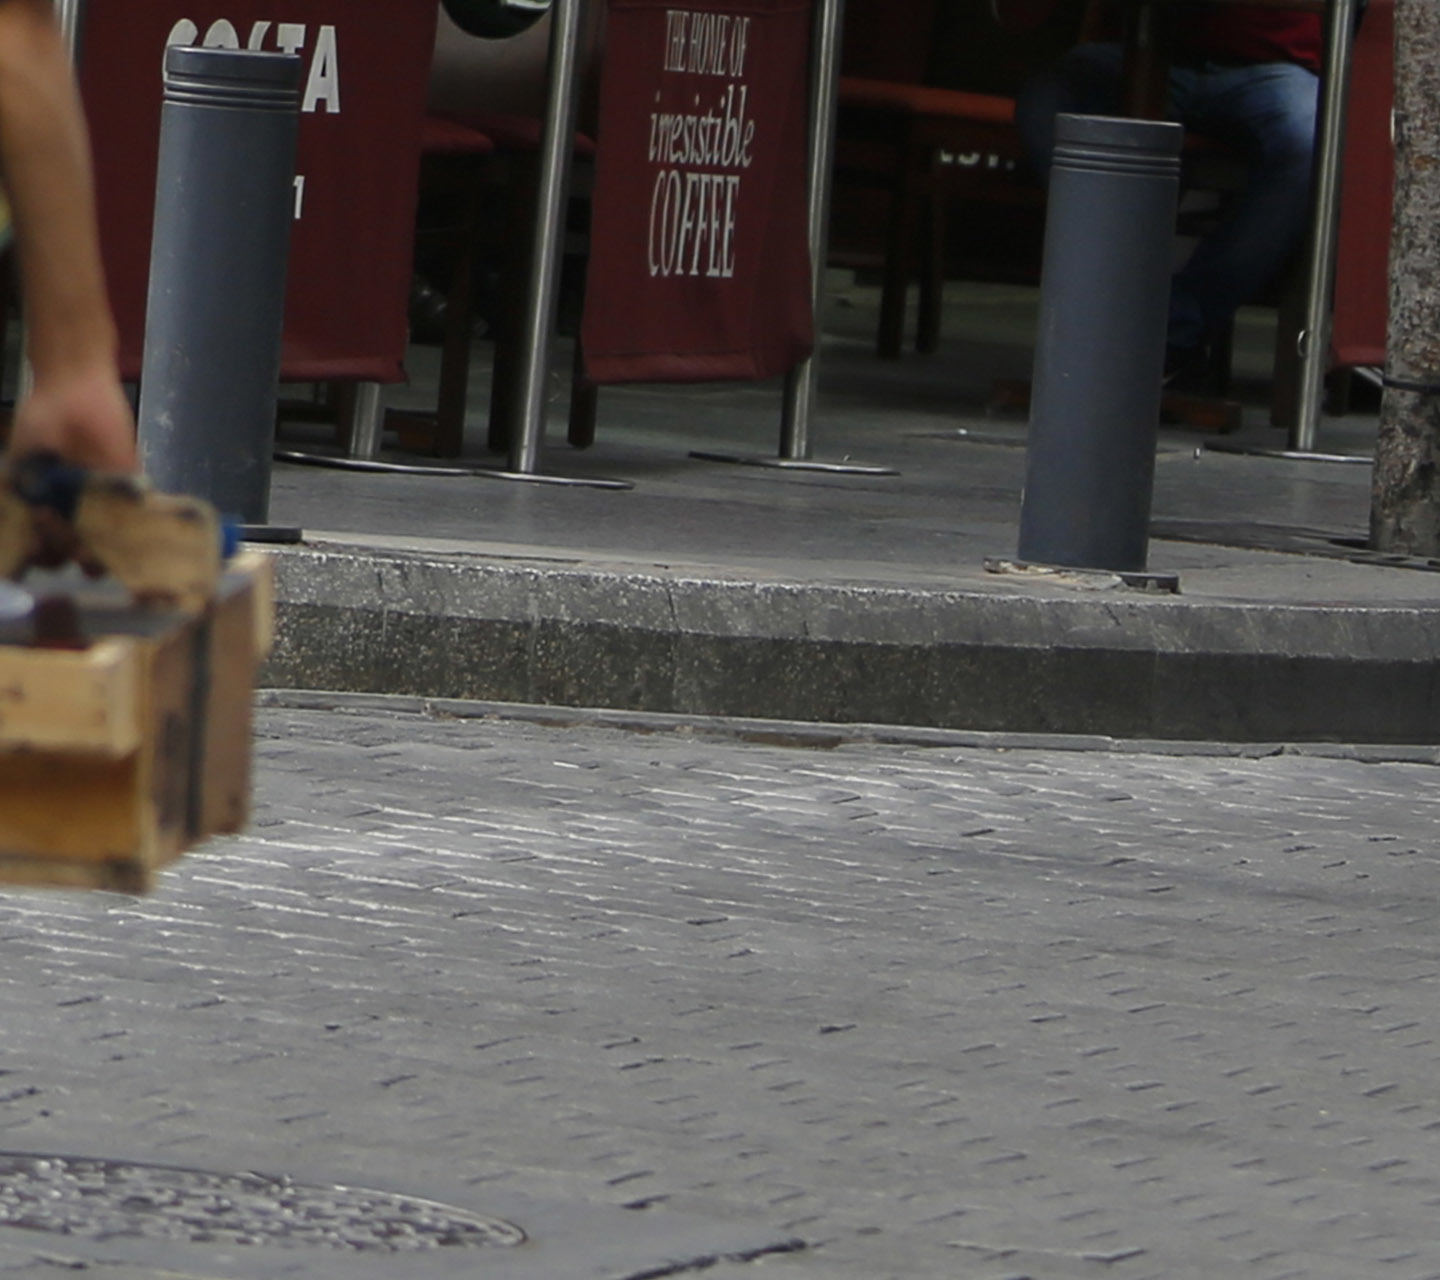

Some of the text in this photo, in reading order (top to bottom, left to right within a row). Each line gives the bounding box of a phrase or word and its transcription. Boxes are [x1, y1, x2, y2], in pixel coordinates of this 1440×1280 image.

[664, 10, 751, 77] THE HOME OF
[648, 83, 754, 168] irresistible
[647, 169, 741, 278] COFFEE
